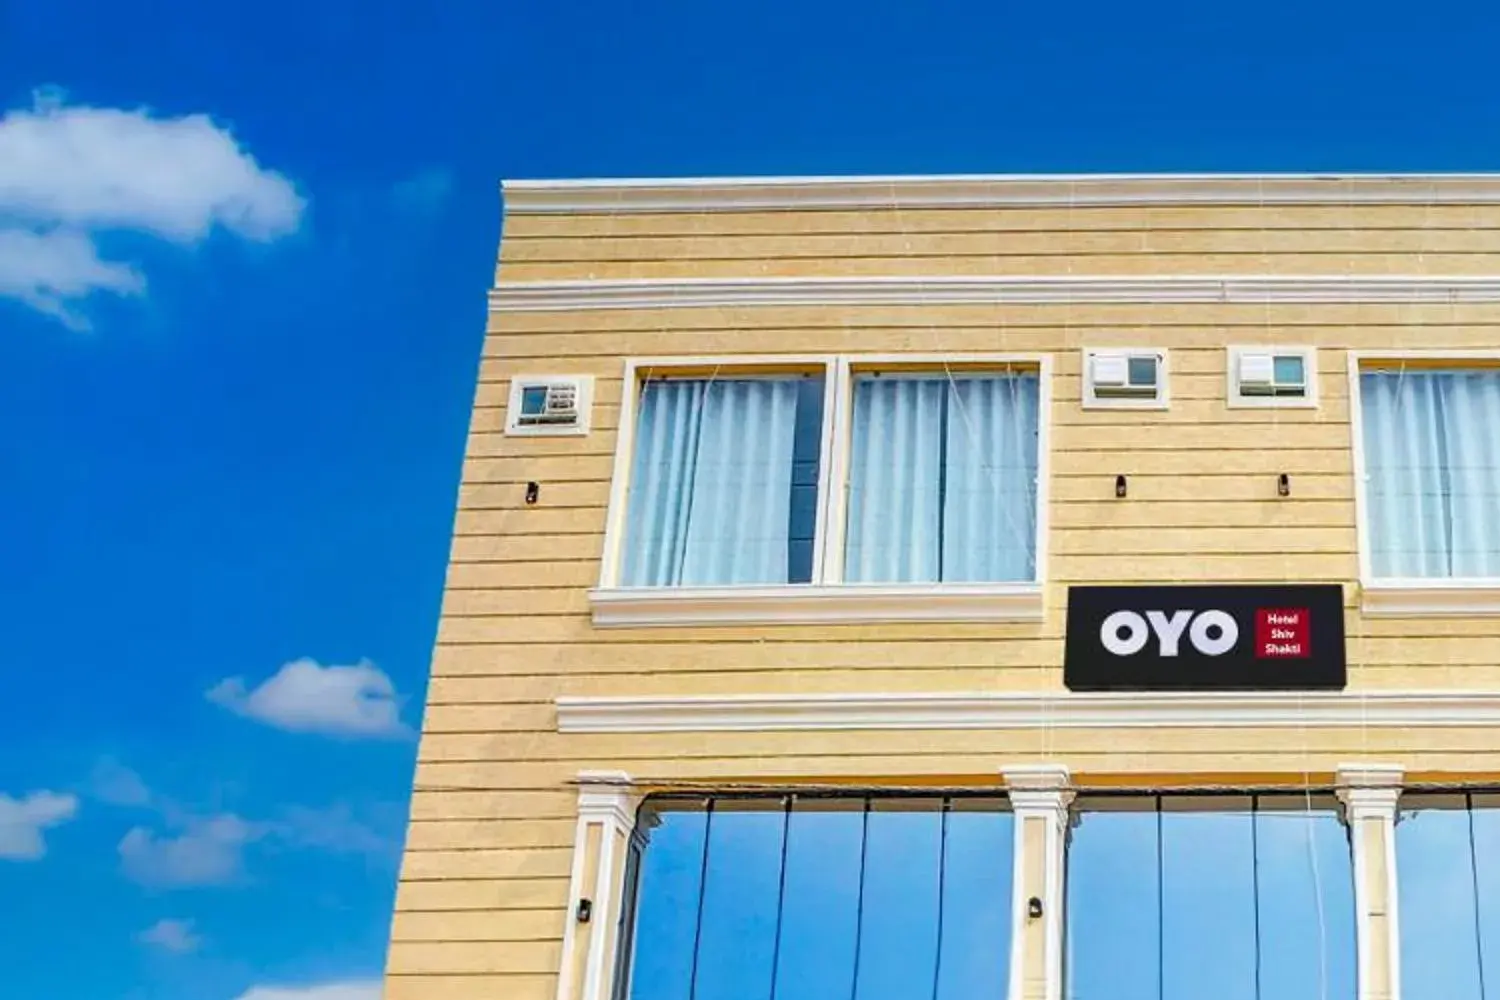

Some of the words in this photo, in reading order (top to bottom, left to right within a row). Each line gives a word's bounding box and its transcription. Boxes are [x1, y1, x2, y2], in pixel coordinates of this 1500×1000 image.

[1267, 613, 1299, 625] Hotel
[1100, 610, 1239, 656] OYO
[1271, 628, 1295, 639] Shiv
[1265, 643, 1301, 655] Shakti
